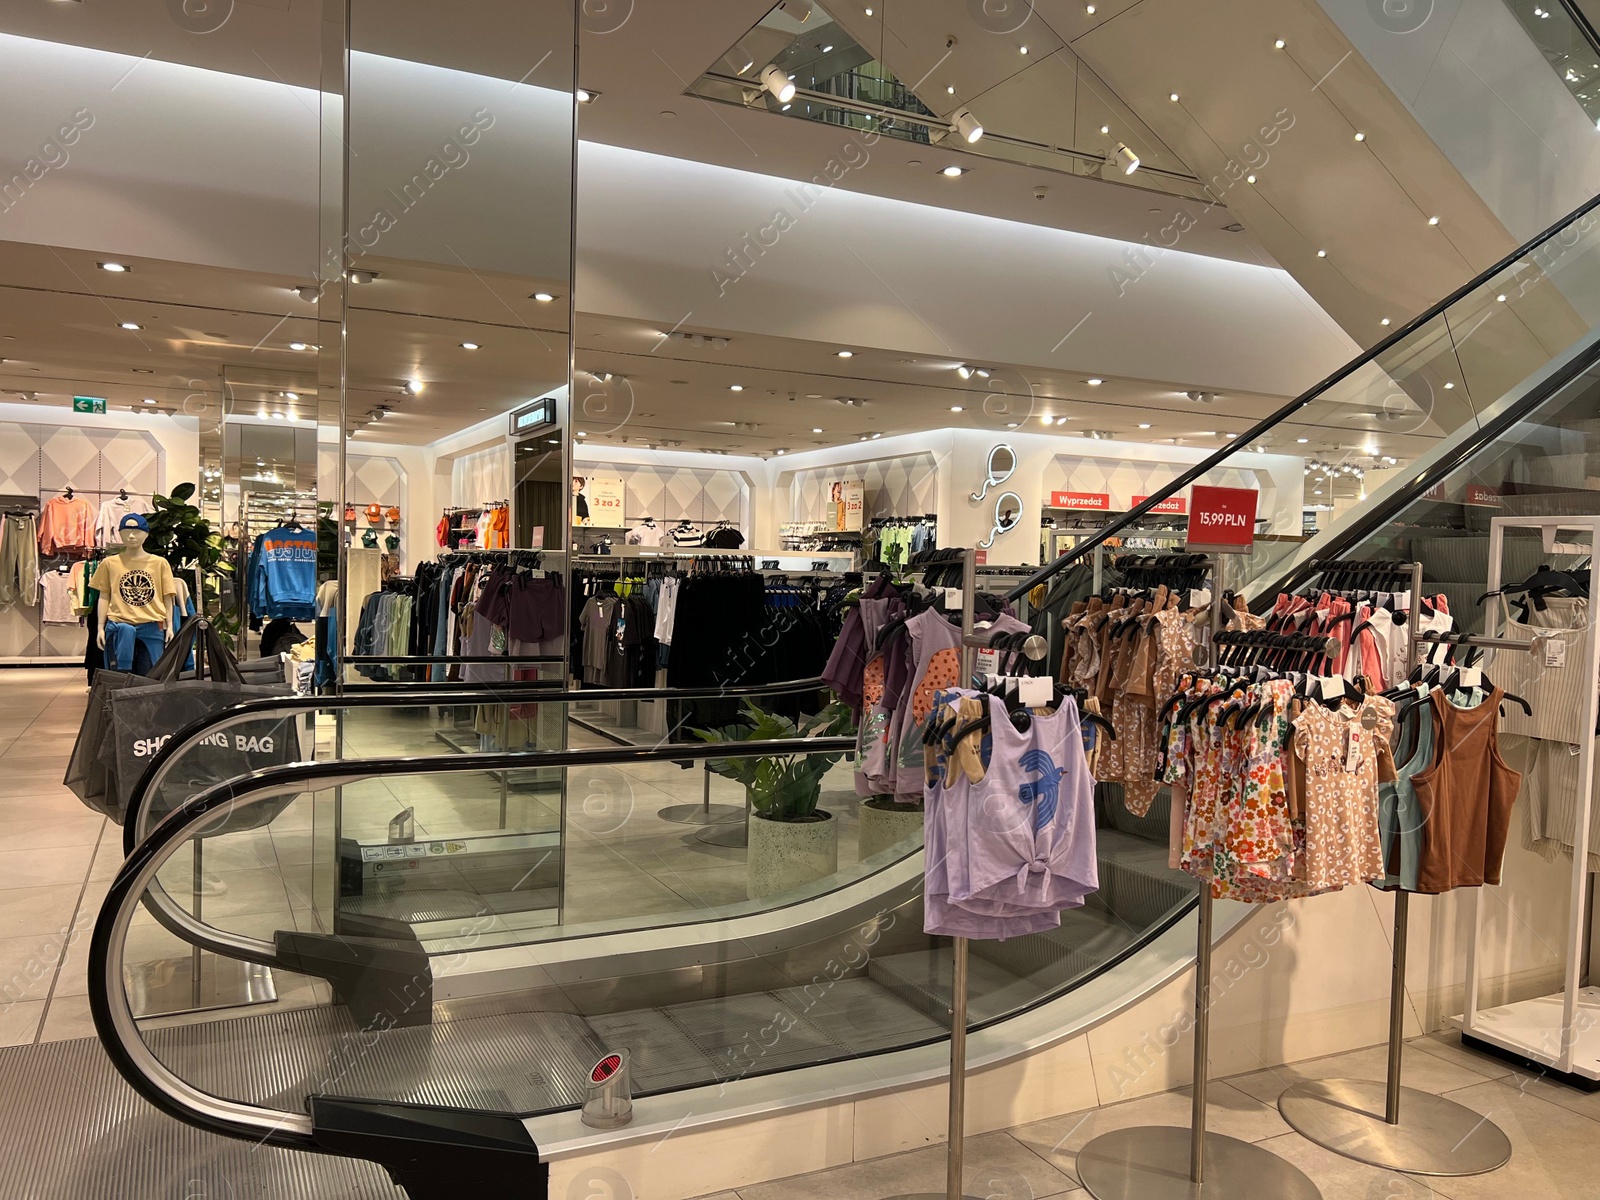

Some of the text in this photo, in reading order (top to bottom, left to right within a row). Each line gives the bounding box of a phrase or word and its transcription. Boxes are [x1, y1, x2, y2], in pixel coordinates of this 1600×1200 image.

[594, 497, 600, 506] 3
[615, 499, 621, 507] 2
[847, 501, 851, 510] 3
[858, 500, 862, 510] 2
[1059, 495, 1103, 506] Wyprzedaż
[1200, 511, 1246, 527] 15,99 PLN
[235, 735, 274, 753] BAG
